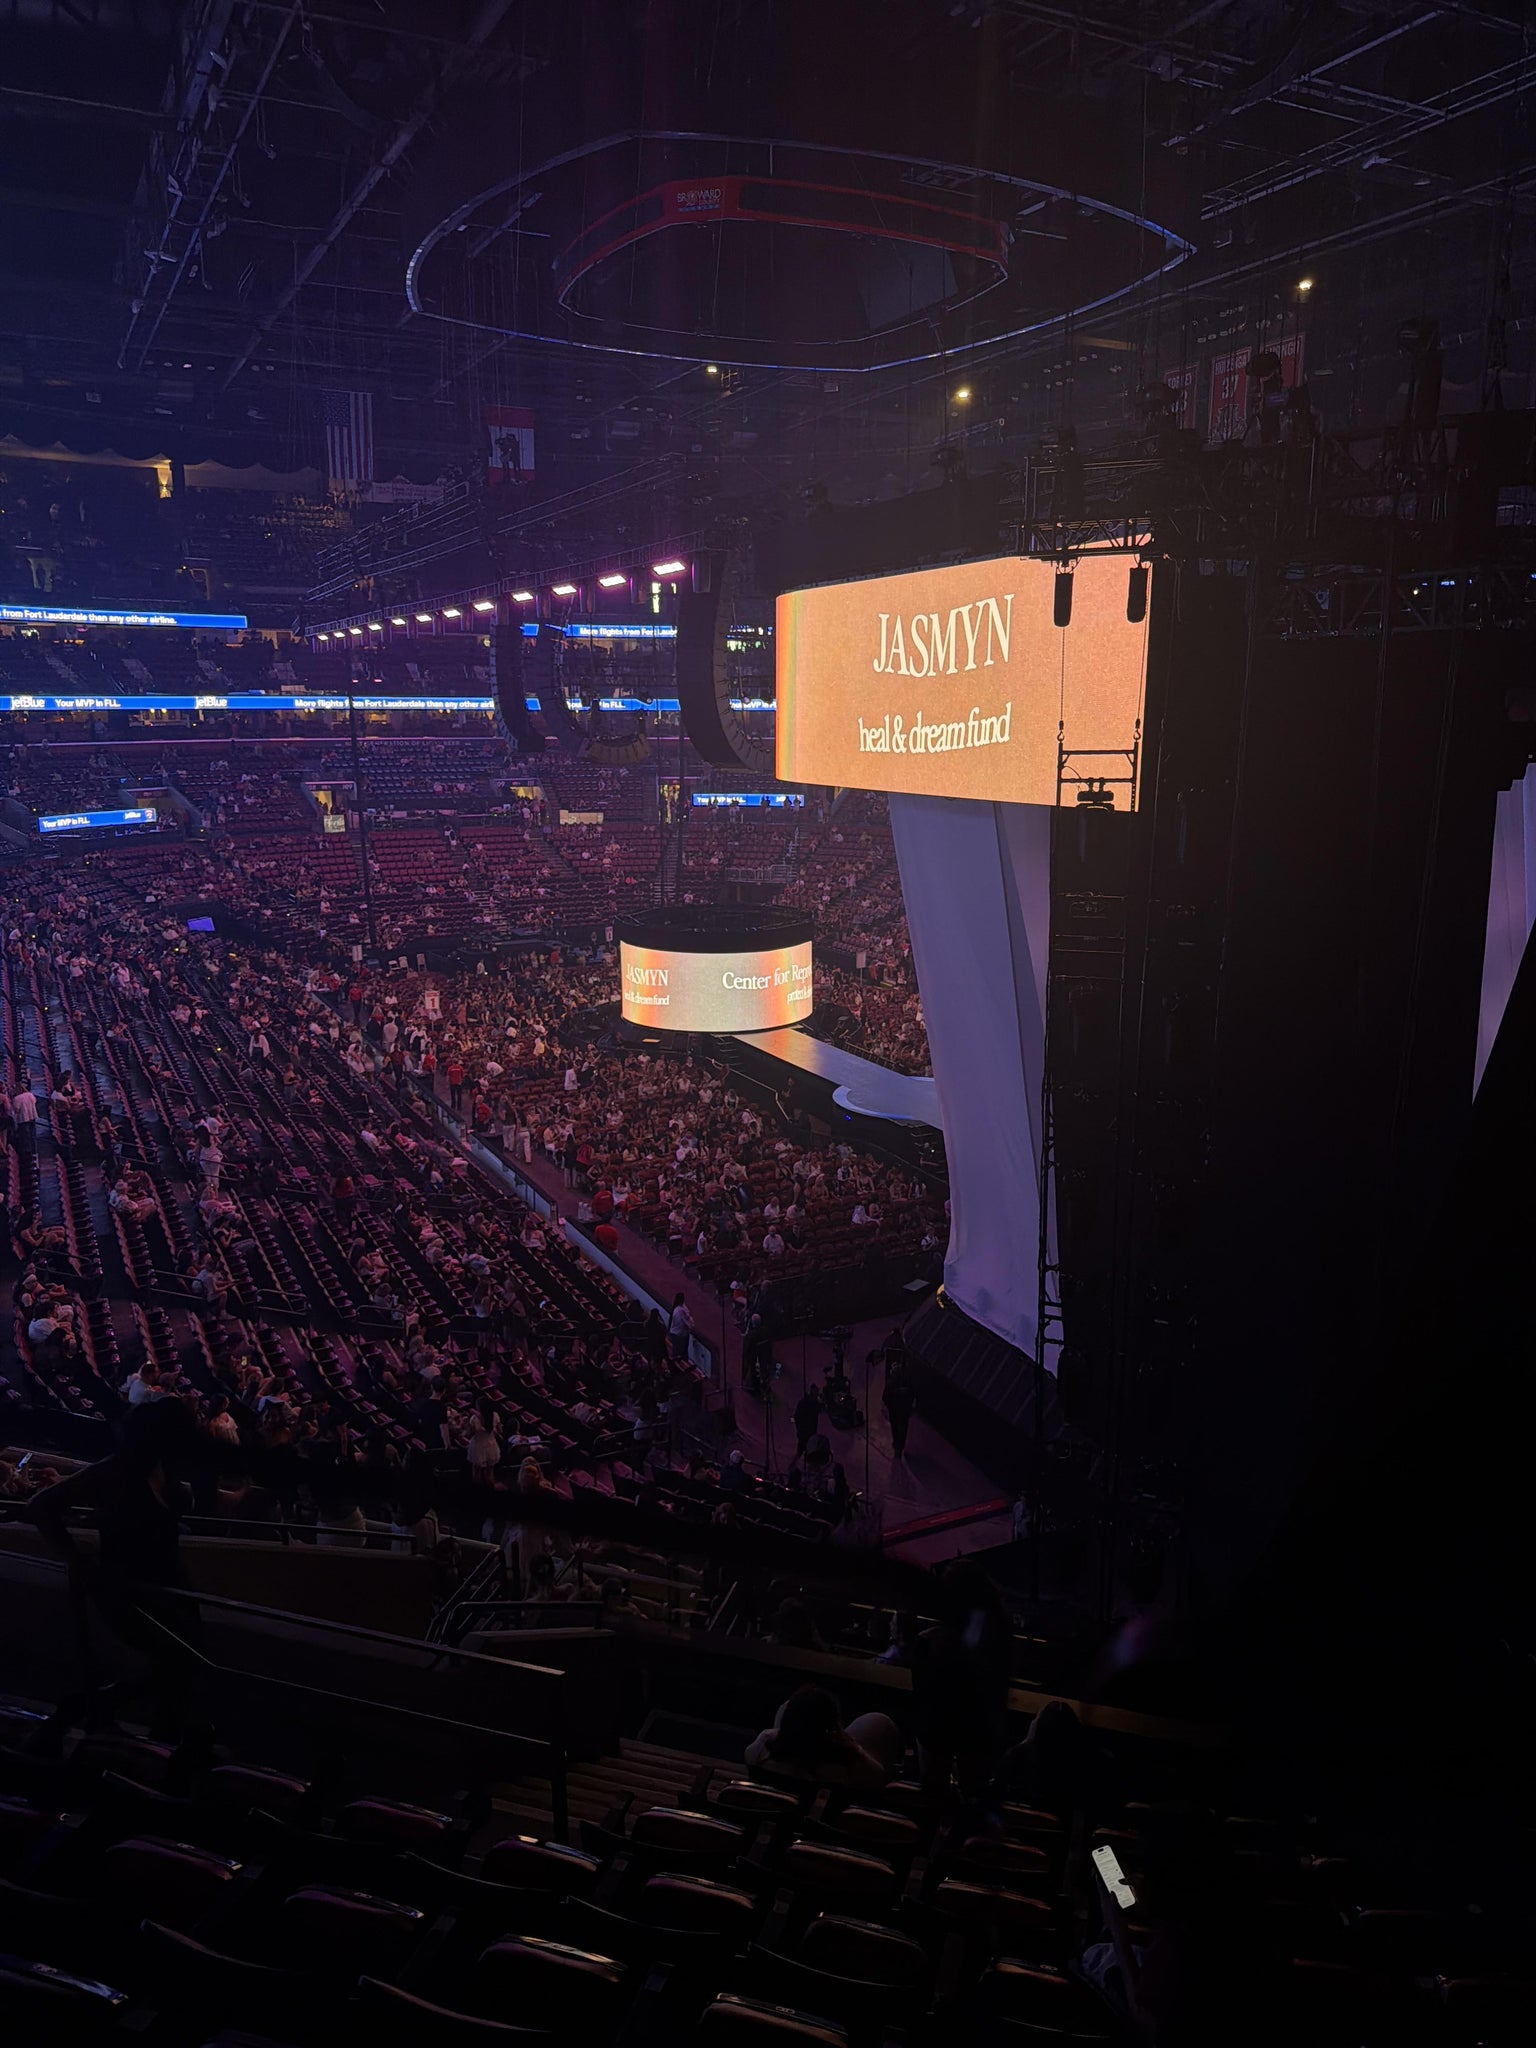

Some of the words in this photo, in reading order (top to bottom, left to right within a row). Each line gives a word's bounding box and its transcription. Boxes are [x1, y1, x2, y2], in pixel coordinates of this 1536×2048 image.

[677, 188, 721, 203] BROWARD
[2, 609, 24, 618] from
[24, 609, 42, 618] Fort
[43, 610, 87, 621] Lauderdale
[88, 613, 107, 622] than
[109, 615, 124, 624] any
[125, 614, 148, 623] other
[873, 594, 1015, 678] JASMYN
[10, 696, 45, 710] jetBlue
[55, 699, 75, 707] Your
[76, 699, 94, 707] MVP
[194, 696, 228, 710] jetBlue
[294, 699, 316, 707] More
[317, 699, 343, 708] flights
[365, 699, 382, 707] Fort
[445, 701, 458, 709] any
[459, 700, 479, 708] other
[858, 717, 891, 752] heal
[892, 715, 907, 753] &
[909, 711, 966, 753] dream
[966, 702, 1012, 747] fund
[625, 963, 669, 986] JASMYN
[722, 971, 772, 990] Center
[773, 967, 791, 986] for
[430, 997, 435, 1008] 1
